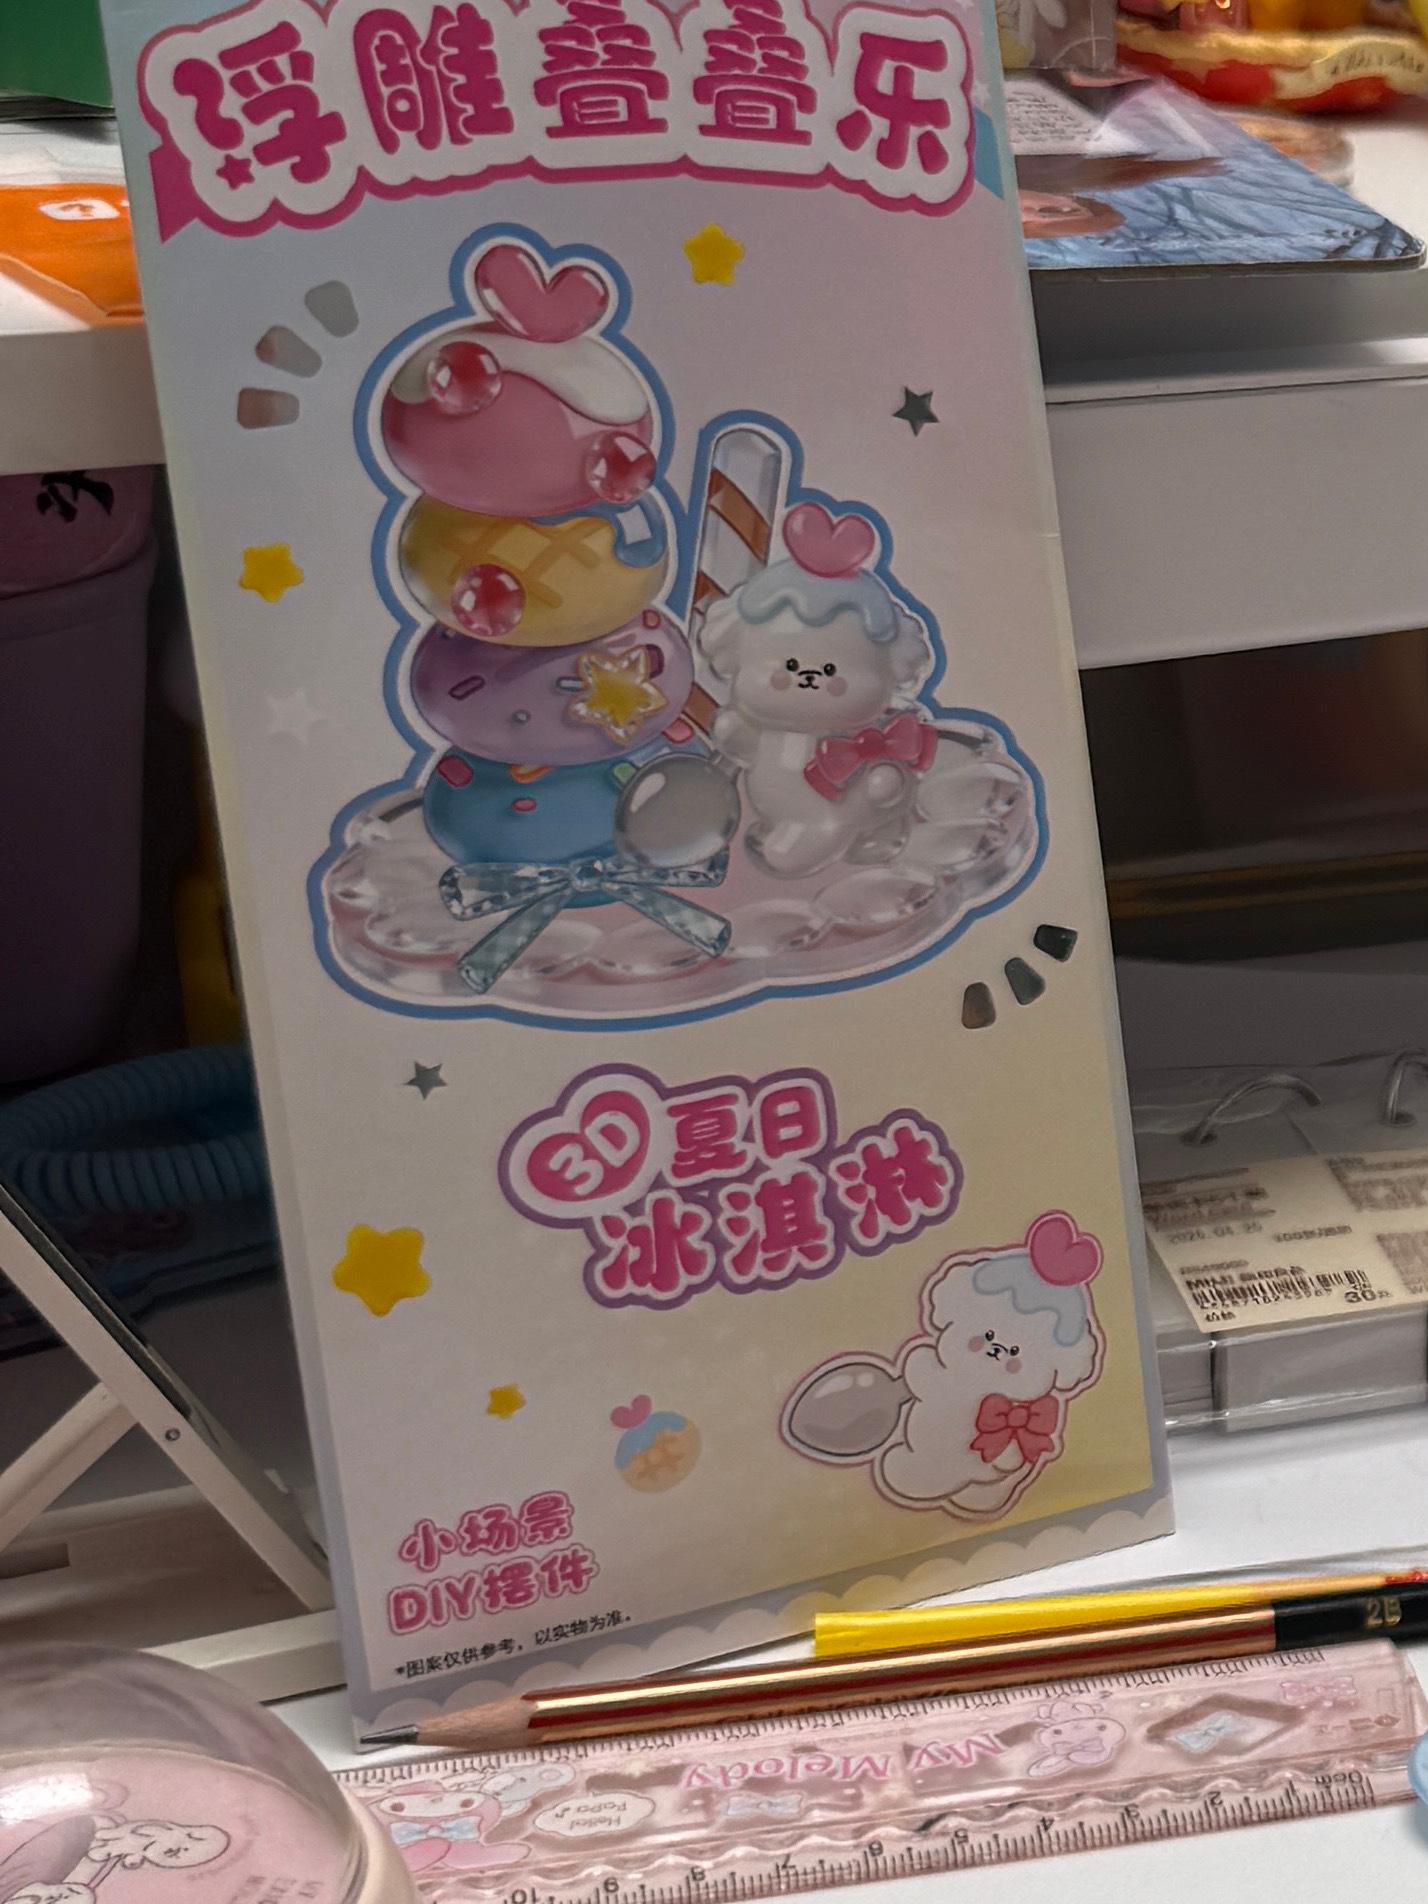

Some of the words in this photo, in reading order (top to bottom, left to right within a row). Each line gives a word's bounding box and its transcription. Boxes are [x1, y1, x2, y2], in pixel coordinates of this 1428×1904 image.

[598, 1118, 948, 1296] 冰淇淋
[401, 1491, 578, 1572] 小场景
[387, 1546, 601, 1636] DIY摆件
[682, 1741, 890, 1793] Melody
[908, 1730, 1003, 1774] My
